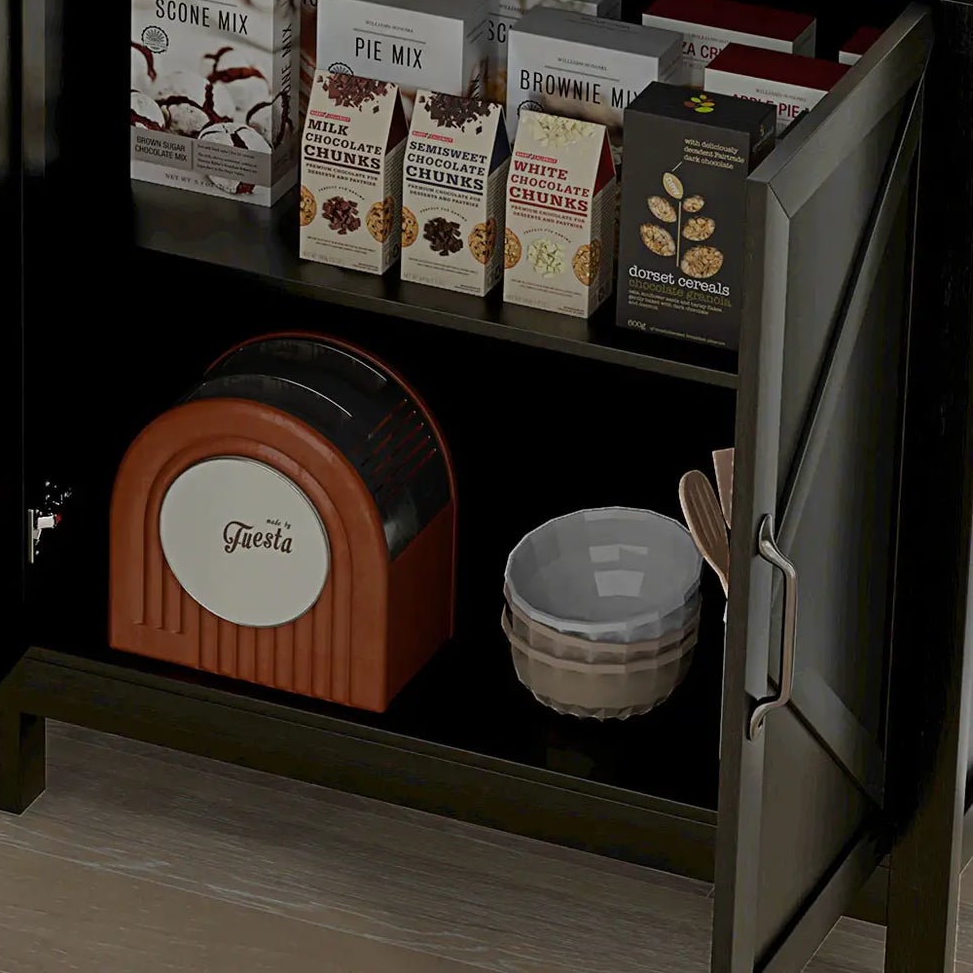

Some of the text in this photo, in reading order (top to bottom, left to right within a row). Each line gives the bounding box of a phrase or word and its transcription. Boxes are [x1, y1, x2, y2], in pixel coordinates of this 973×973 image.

[218, 10, 248, 35] MIX
[355, 37, 423, 70] PIE MIX
[520, 69, 601, 105] BROWNIE
[778, 102, 800, 118] PIE
[307, 118, 349, 136] MILK
[134, 145, 187, 162] CHOCOLATE MIX
[135, 136, 186, 152] BROWN SUGAR
[305, 132, 382, 156] CHOCOLATE
[409, 141, 488, 164] SEMISWEET
[684, 138, 701, 147] with
[304, 144, 381, 170] CHUNKS
[407, 153, 485, 177] CHOCOLATE
[683, 154, 701, 163] dark
[406, 165, 484, 191] CHUNKS
[513, 159, 568, 181] WHITE
[510, 174, 590, 197] CHOCOLATE
[509, 186, 588, 212] CHUNKS
[628, 264, 731, 297] dorset cereals
[628, 277, 684, 297] chocolate
[686, 289, 732, 308] granola
[627, 318, 647, 331] 600g
[284, 521, 292, 530] by
